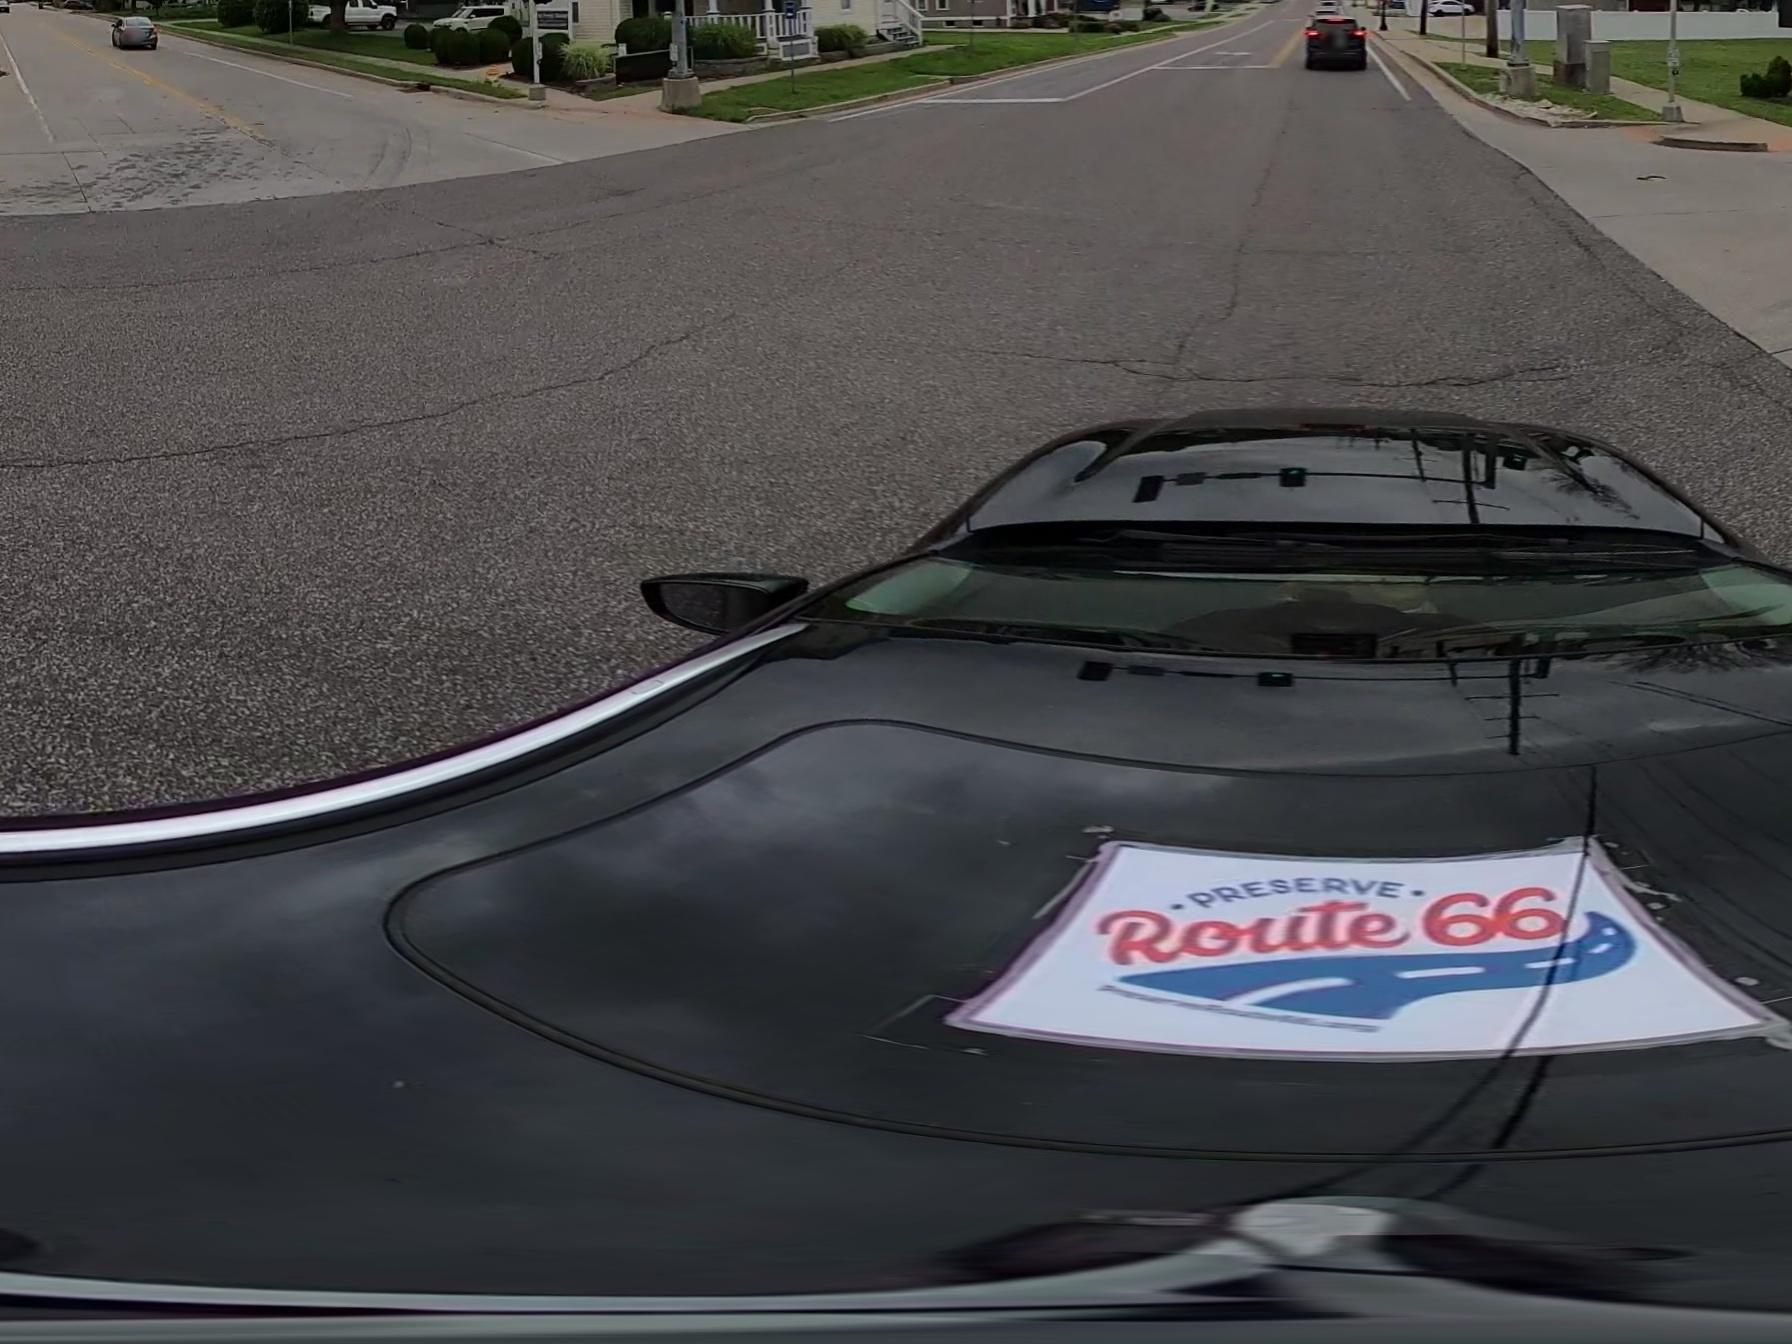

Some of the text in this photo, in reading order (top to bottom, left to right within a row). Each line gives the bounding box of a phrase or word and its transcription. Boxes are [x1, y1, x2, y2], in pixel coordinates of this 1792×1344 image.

[1188, 876, 1403, 908] PRESERVE
[1096, 886, 1565, 966] Route 66
